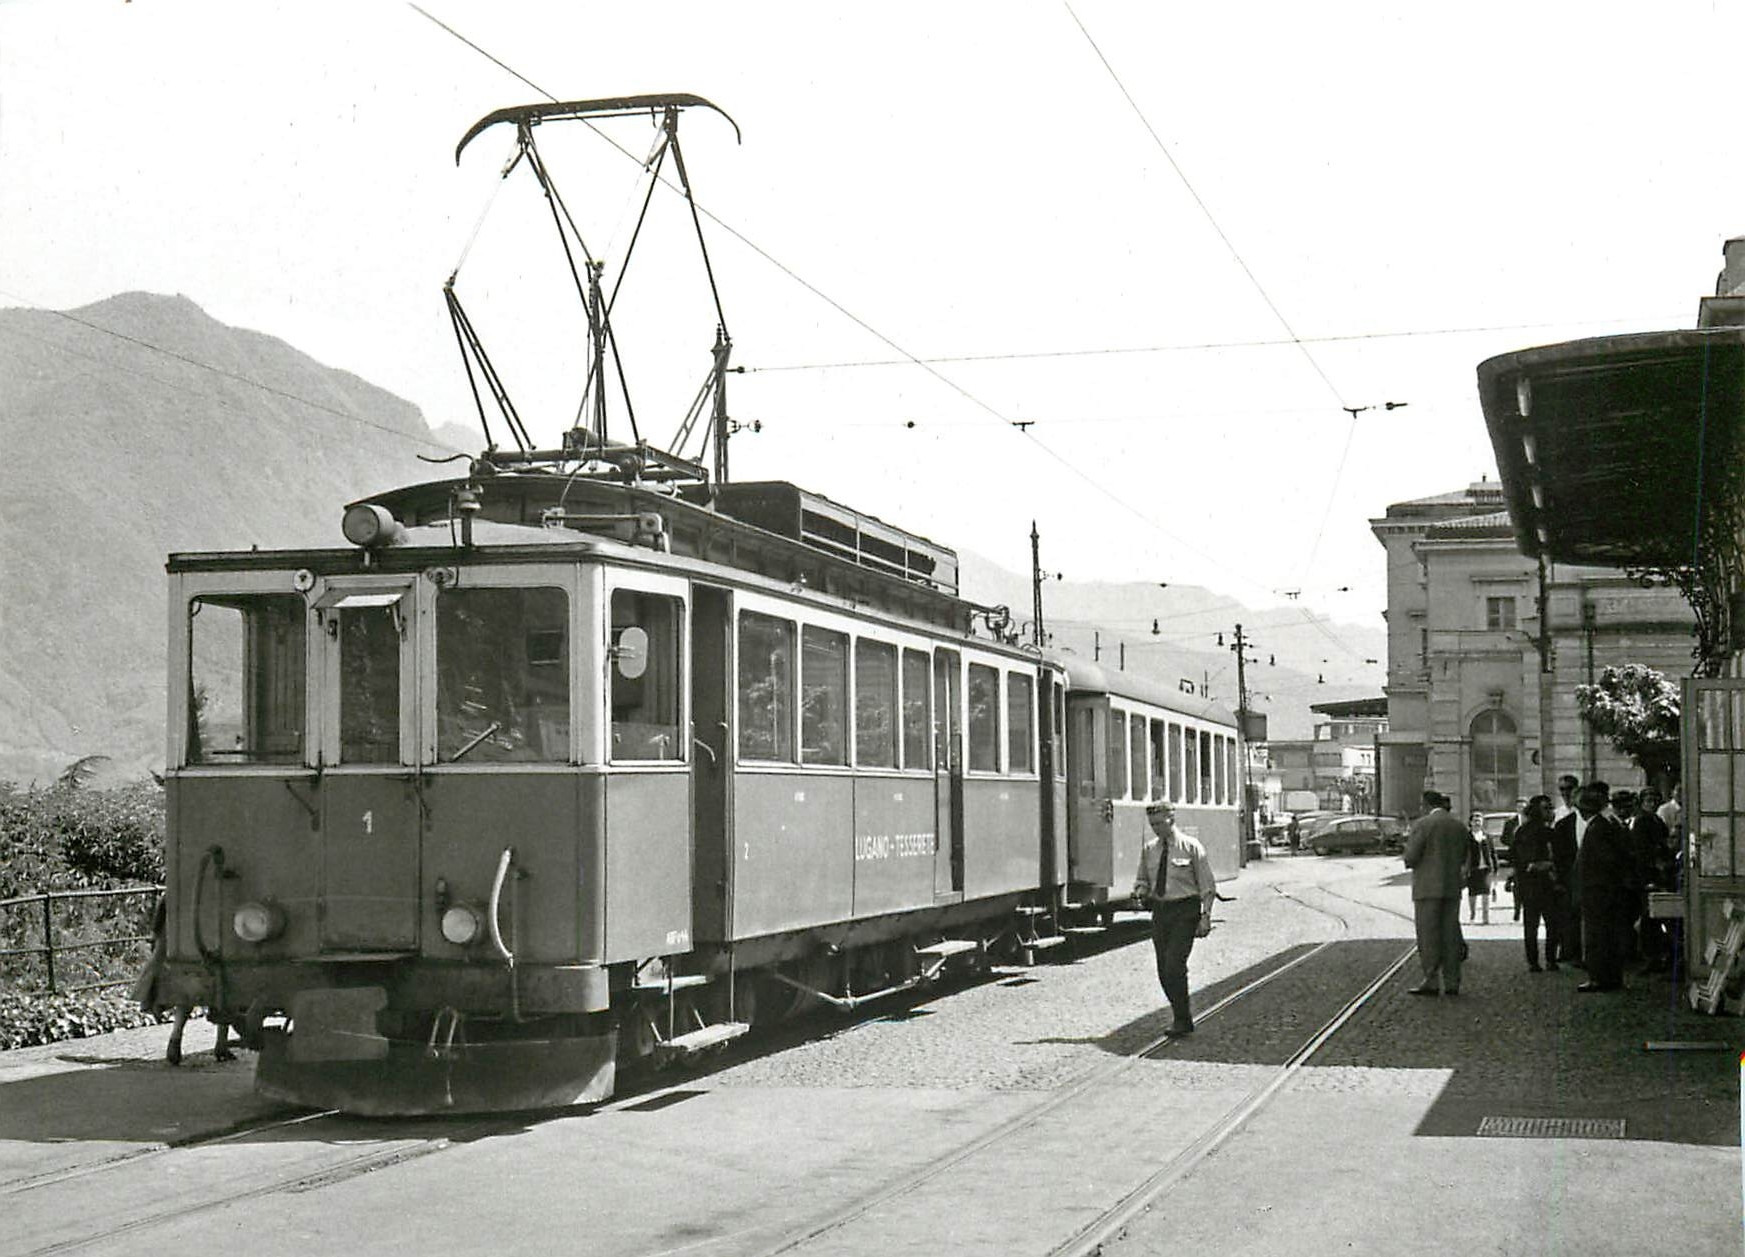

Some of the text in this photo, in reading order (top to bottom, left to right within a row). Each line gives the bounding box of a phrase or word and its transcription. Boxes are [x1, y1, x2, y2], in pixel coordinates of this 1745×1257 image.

[362, 810, 372, 833] 1
[855, 835, 889, 860] LUGANO
[895, 833, 934, 857] TESSERETE
